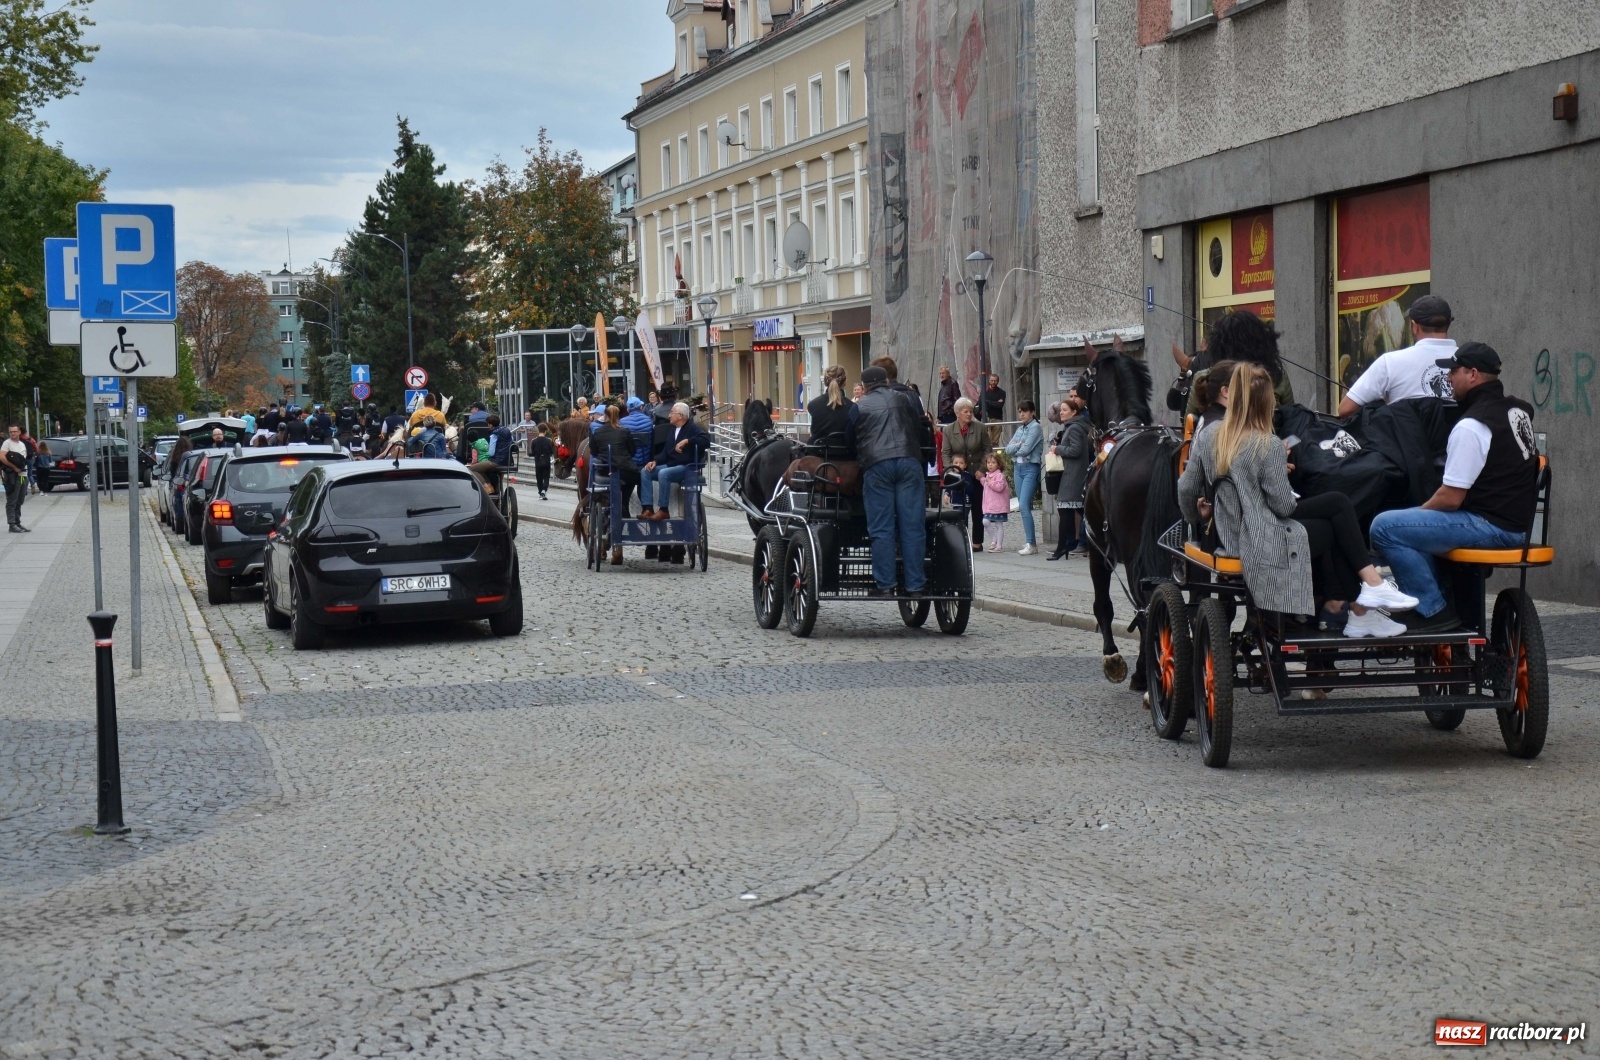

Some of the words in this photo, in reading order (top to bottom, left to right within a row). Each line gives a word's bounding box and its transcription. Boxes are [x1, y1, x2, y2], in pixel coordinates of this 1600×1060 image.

[101, 214, 155, 285] P
[1369, 293, 1379, 303] nas
[138, 407, 145, 416] P
[177, 414, 184, 422] P
[390, 578, 413, 590] SRC
[417, 576, 447, 588] 6WH3
